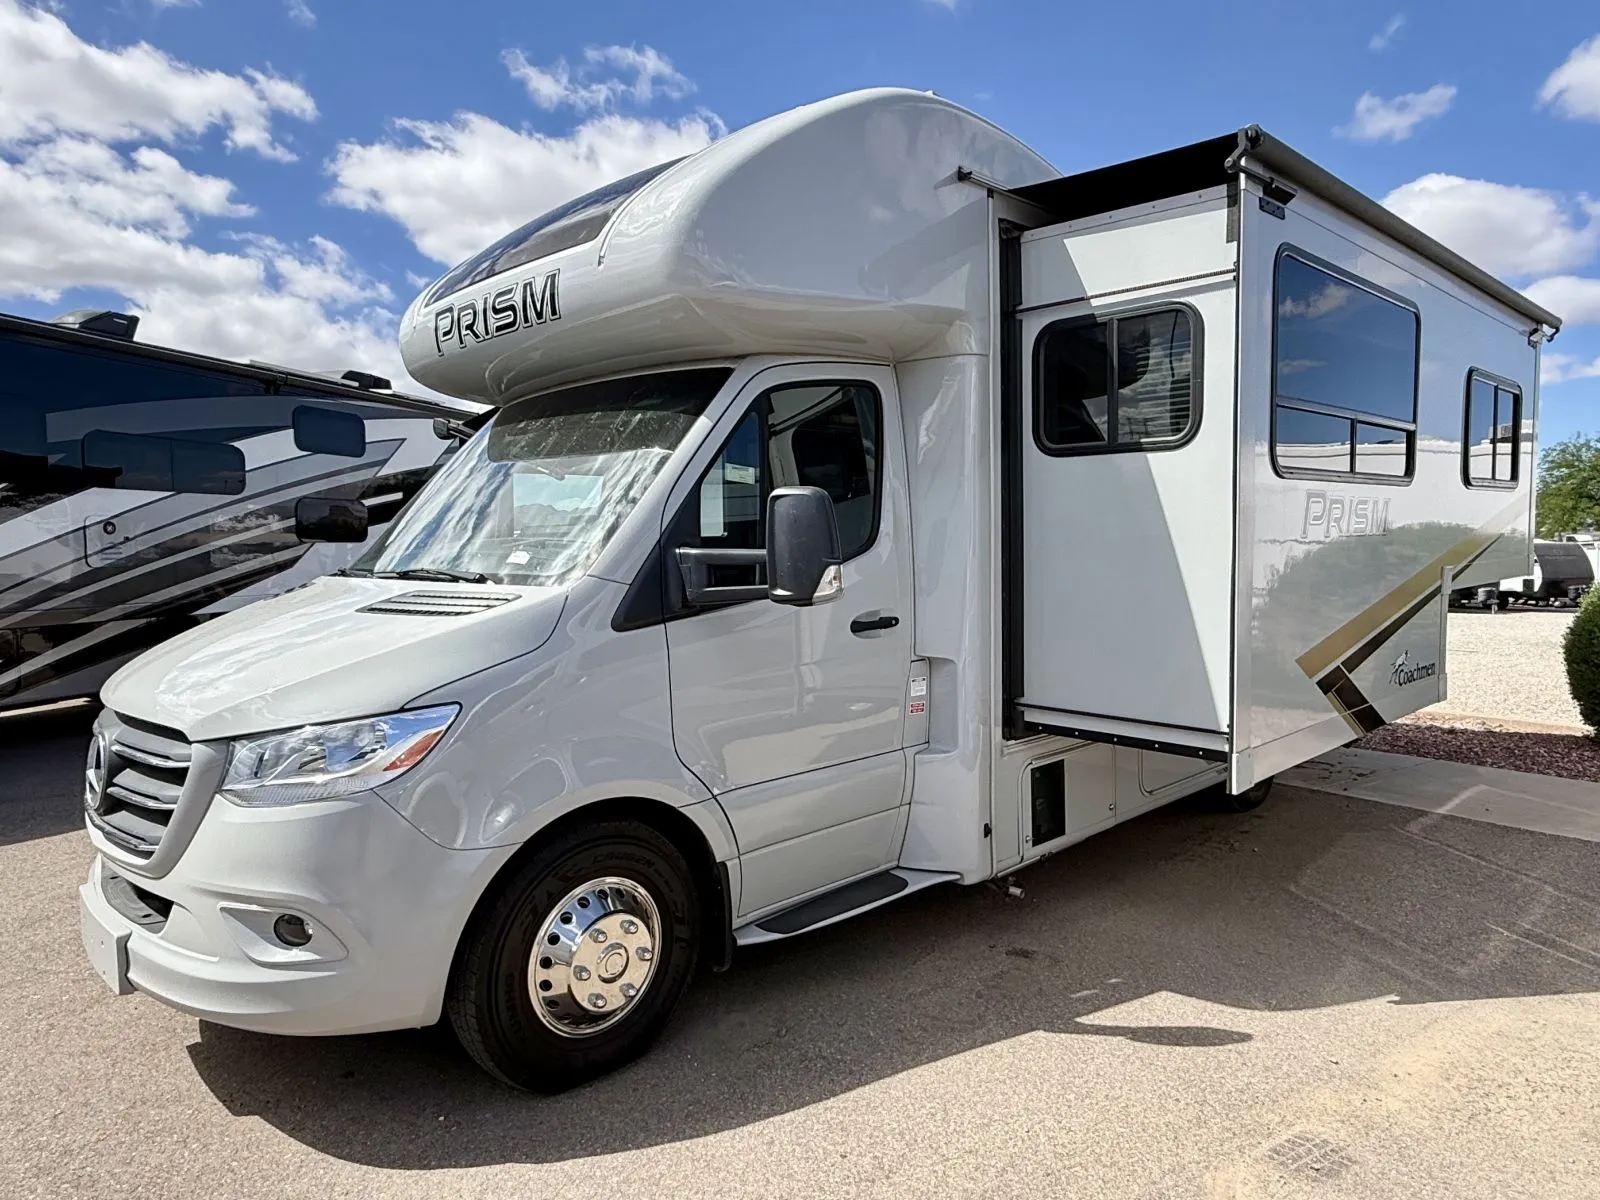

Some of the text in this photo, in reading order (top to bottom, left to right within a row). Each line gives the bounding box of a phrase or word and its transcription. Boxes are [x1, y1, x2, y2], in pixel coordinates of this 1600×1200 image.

[434, 268, 562, 358] PRISM
[1300, 488, 1392, 539] PRISM
[1398, 662, 1436, 687] Coachmen
